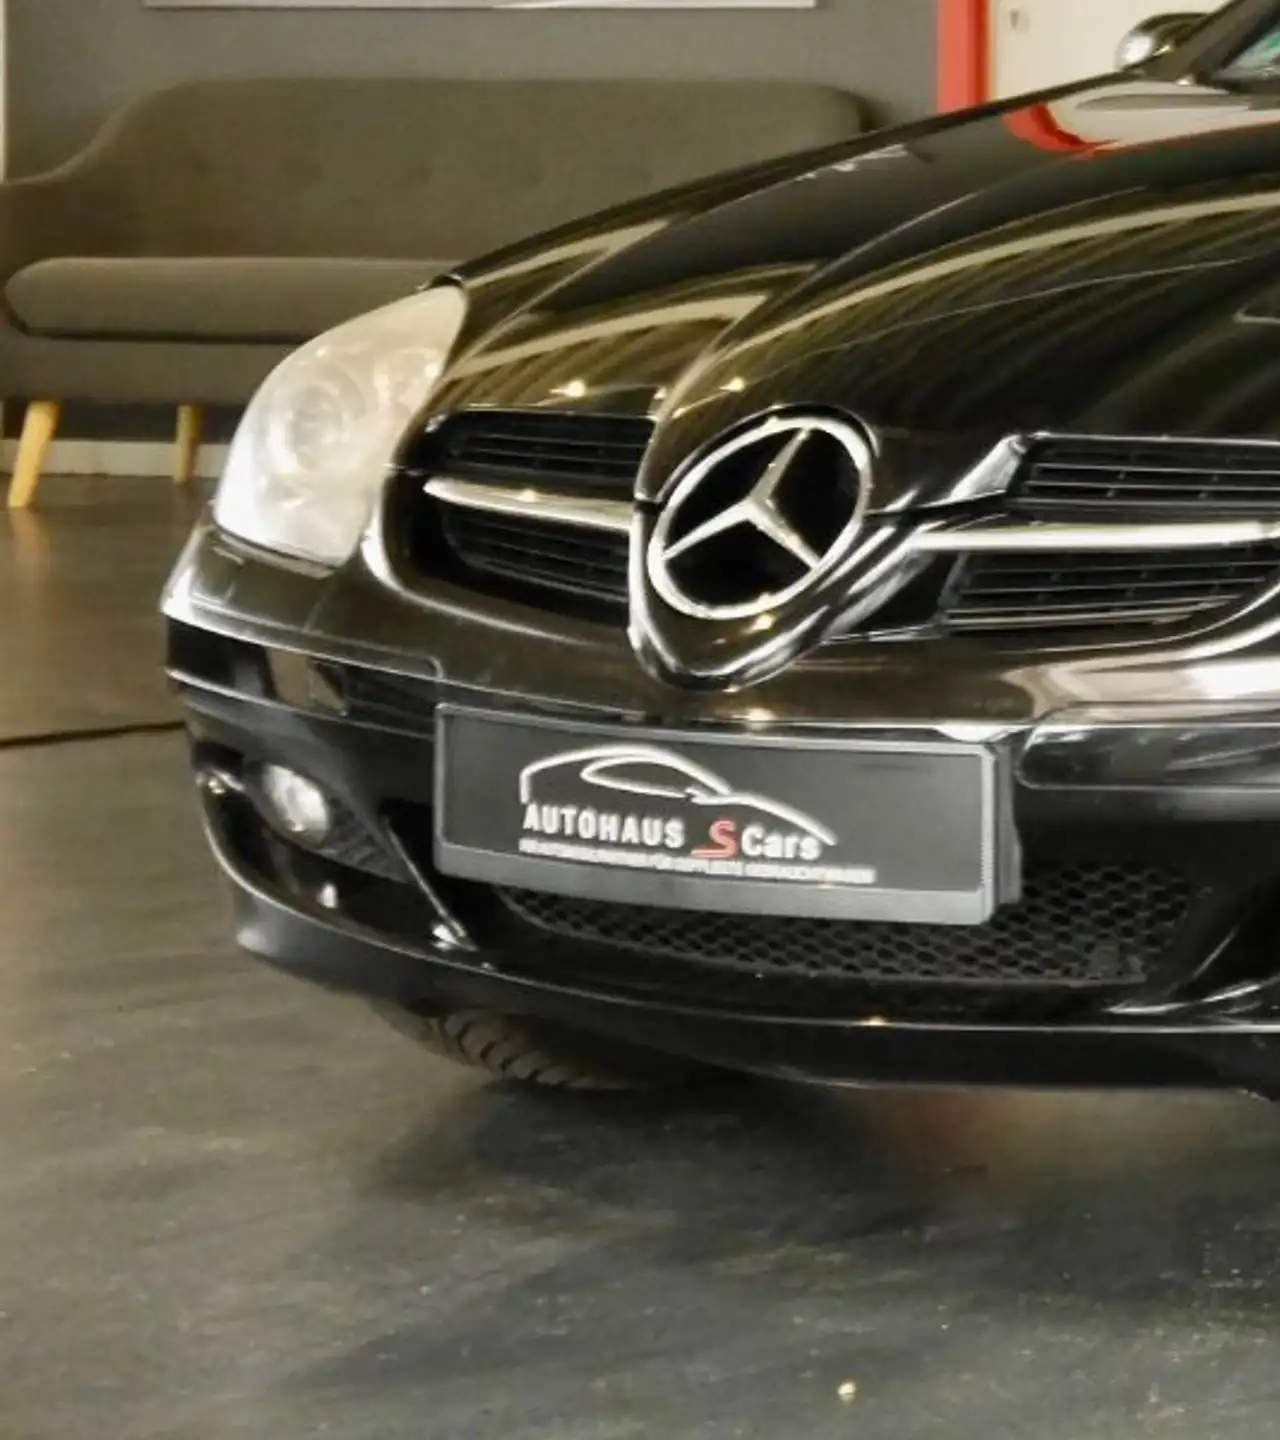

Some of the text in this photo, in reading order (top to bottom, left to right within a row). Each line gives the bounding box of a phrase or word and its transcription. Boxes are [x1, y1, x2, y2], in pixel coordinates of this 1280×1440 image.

[522, 803, 822, 860] AUTOHAUS S Cars
